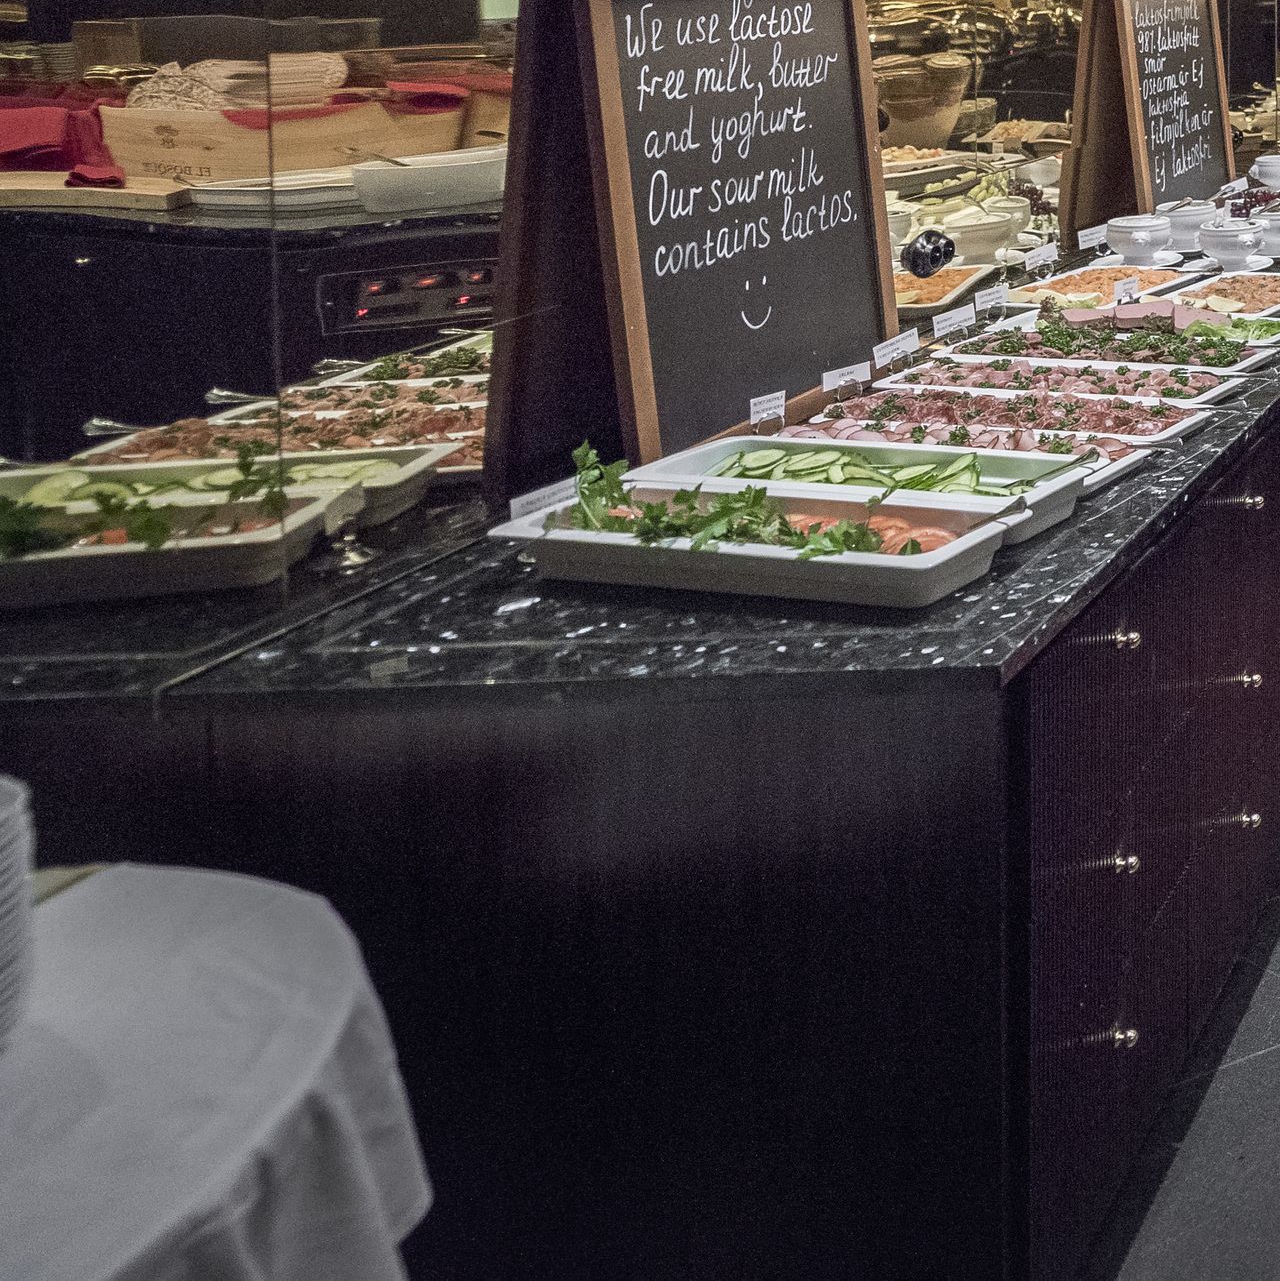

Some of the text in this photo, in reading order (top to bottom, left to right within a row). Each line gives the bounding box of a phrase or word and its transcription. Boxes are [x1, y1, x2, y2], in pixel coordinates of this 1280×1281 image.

[625, 3, 663, 57] We
[677, 14, 720, 45] use
[637, 41, 838, 111] free milk, butter
[1144, 53, 1166, 74] smör
[1179, 64, 1190, 86] är
[1192, 57, 1204, 89] Ej
[1149, 89, 1190, 118] laktosfria
[1202, 103, 1213, 127] är
[644, 96, 814, 163] and yoghurt.
[1154, 151, 1166, 192] Ej
[649, 169, 702, 226] Our
[655, 189, 857, 276] contains lactos.
